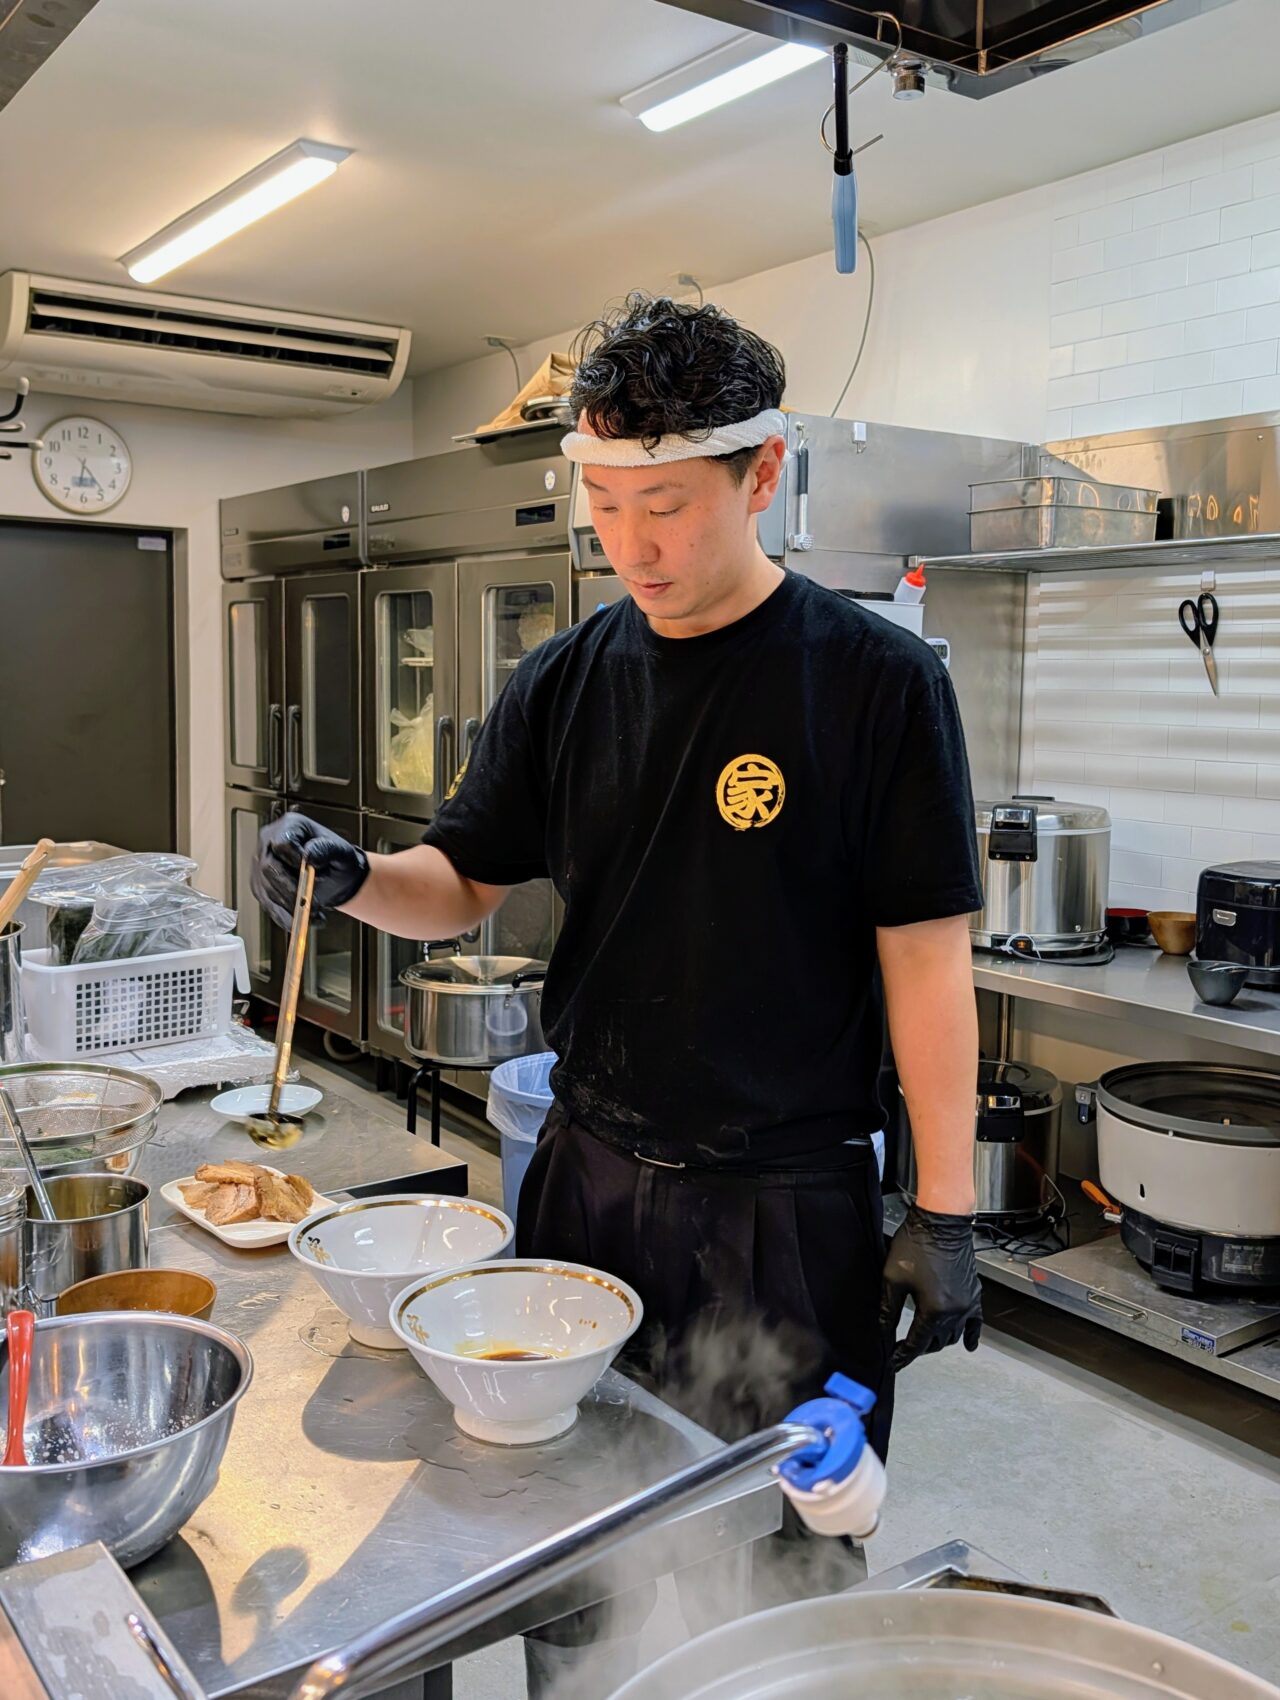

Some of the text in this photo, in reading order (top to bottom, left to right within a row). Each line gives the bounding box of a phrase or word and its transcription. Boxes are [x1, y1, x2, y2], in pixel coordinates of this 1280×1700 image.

[62, 430, 71, 441] 11
[78, 427, 89, 439] 12
[98, 433, 102, 445] 1
[49, 441, 60, 453] 10
[109, 445, 116, 457] 2
[44, 457, 52, 470] 9
[115, 463, 122, 474] 3
[50, 473, 58, 485] 8
[108, 479, 116, 490] 4
[63, 486, 71, 498] 7
[80, 492, 88, 504] 6
[96, 488, 105, 501] 5
[725, 762, 780, 828] 家
